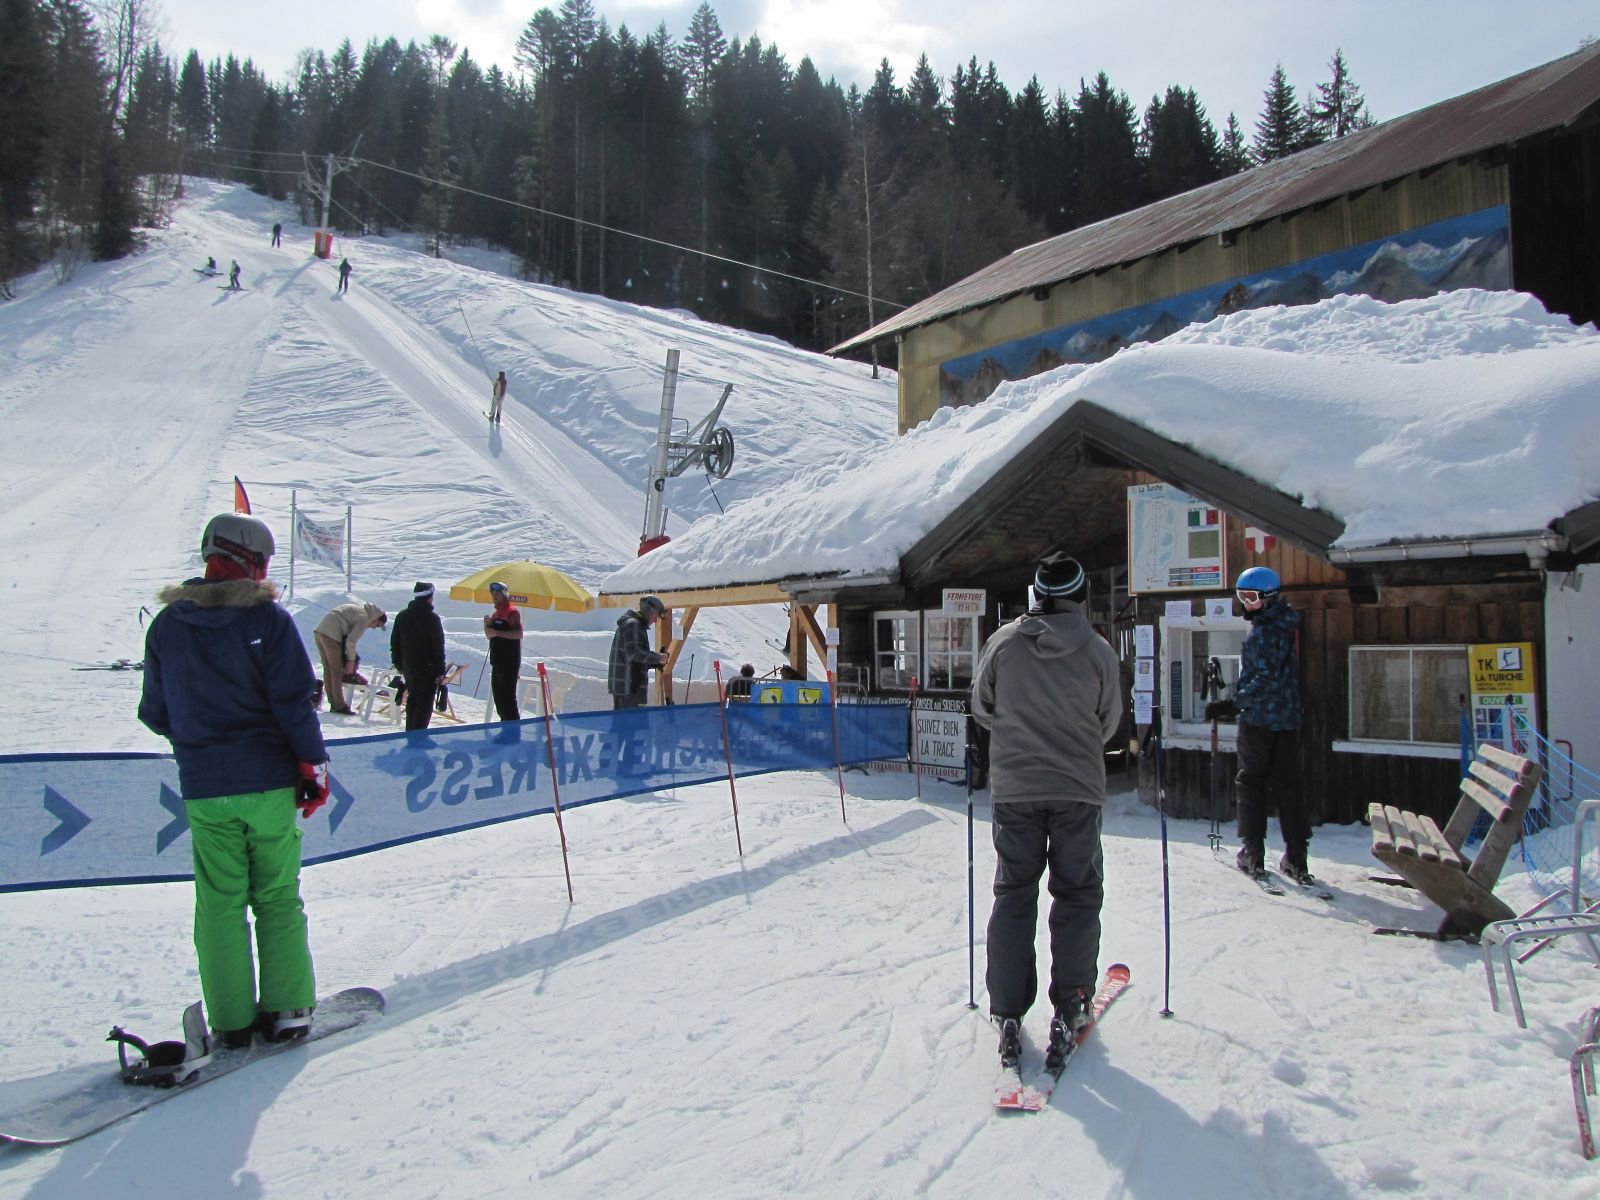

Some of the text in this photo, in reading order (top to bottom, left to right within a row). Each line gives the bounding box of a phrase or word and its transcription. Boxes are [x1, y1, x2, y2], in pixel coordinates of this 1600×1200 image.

[946, 592, 984, 601] FERMETURE
[1477, 658, 1494, 671] TK
[1475, 673, 1523, 682] LA TURCHE
[917, 719, 941, 735] SUIVEZ
[920, 740, 930, 755] LA
